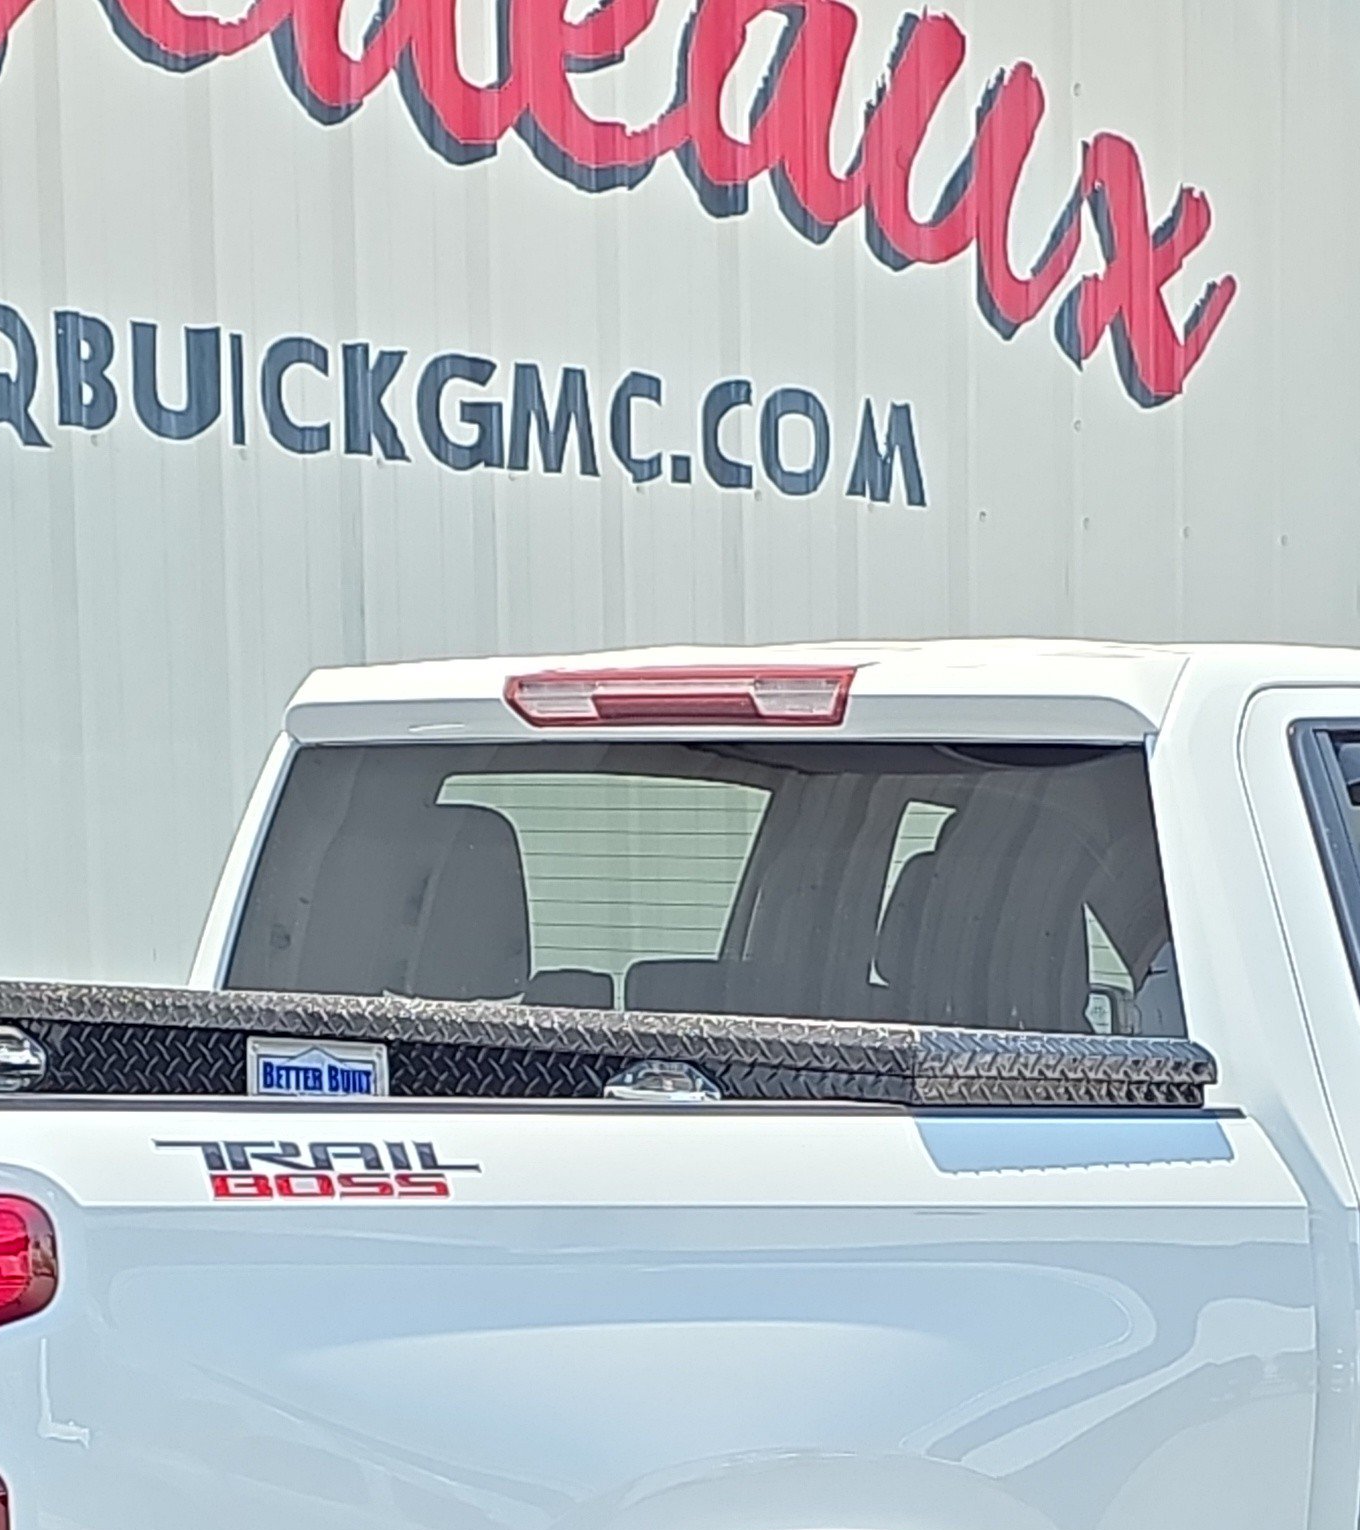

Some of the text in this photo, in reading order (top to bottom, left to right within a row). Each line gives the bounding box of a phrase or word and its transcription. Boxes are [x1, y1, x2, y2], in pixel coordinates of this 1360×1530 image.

[262, 1061, 374, 1095] BETTER BUILT
[152, 1140, 482, 1173] TRAIL
[209, 1173, 451, 1198] BOSS
